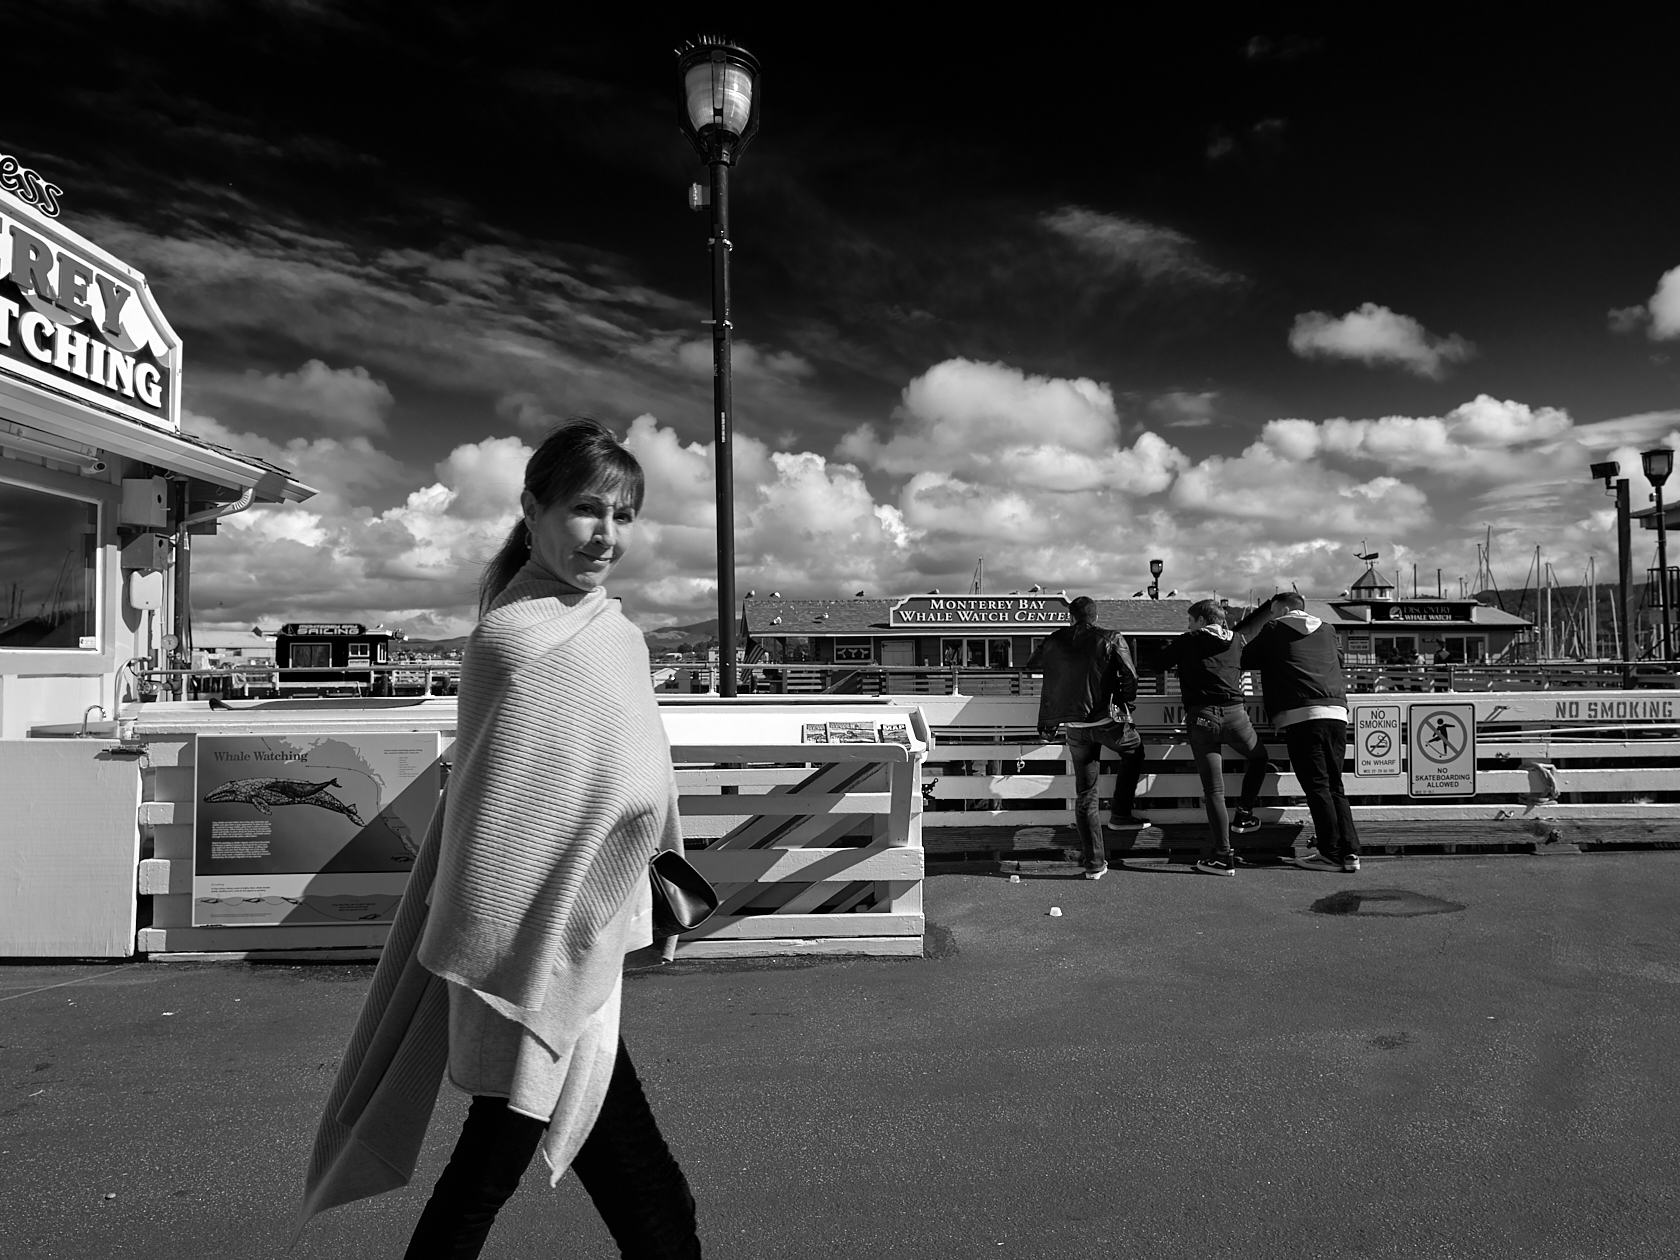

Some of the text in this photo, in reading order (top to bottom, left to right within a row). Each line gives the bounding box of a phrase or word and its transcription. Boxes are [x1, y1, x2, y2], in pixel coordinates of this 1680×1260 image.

[0, 218, 131, 337] REY
[930, 599, 1046, 610] MONTEREY BAY
[1403, 606, 1451, 614] DISCOVERY
[899, 611, 953, 622] WHALE
[957, 611, 1009, 622] WATCH
[1370, 710, 1386, 720] NO
[1555, 701, 1673, 719] NO SMOKING
[1359, 719, 1398, 729] SMOKING
[213, 751, 309, 763] Whale Watching
